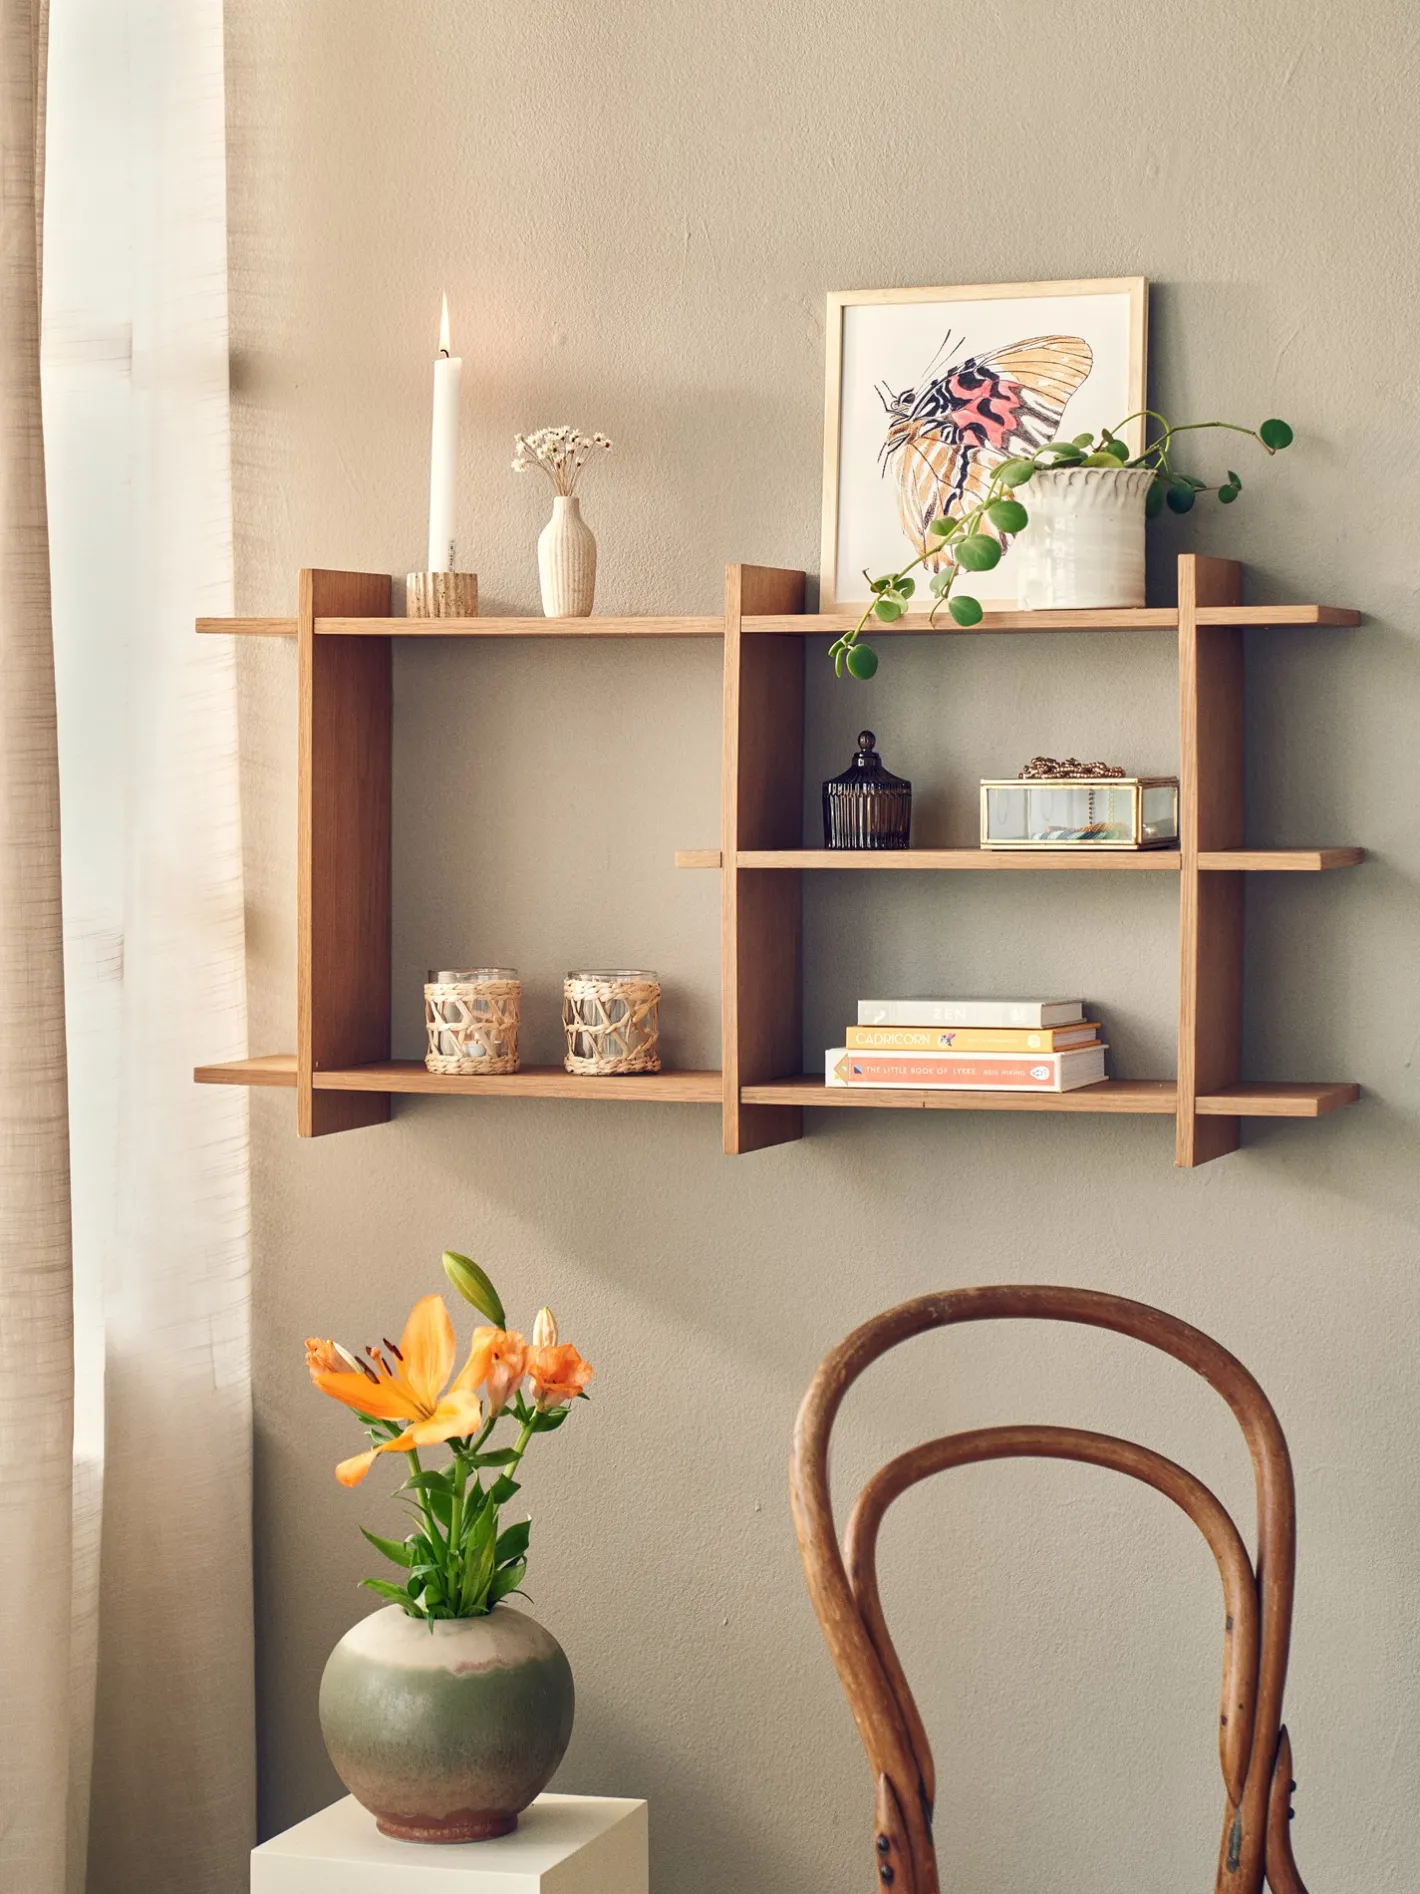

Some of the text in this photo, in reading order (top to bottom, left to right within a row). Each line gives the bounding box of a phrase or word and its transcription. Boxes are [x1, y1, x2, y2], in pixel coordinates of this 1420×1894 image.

[932, 1008, 967, 1021] ZEN
[855, 1032, 932, 1046] CAPRICORN
[866, 1066, 881, 1074] THE
[883, 1067, 908, 1075] LITTLE
[910, 1067, 934, 1075] BOOK
[936, 1067, 948, 1075] OF
